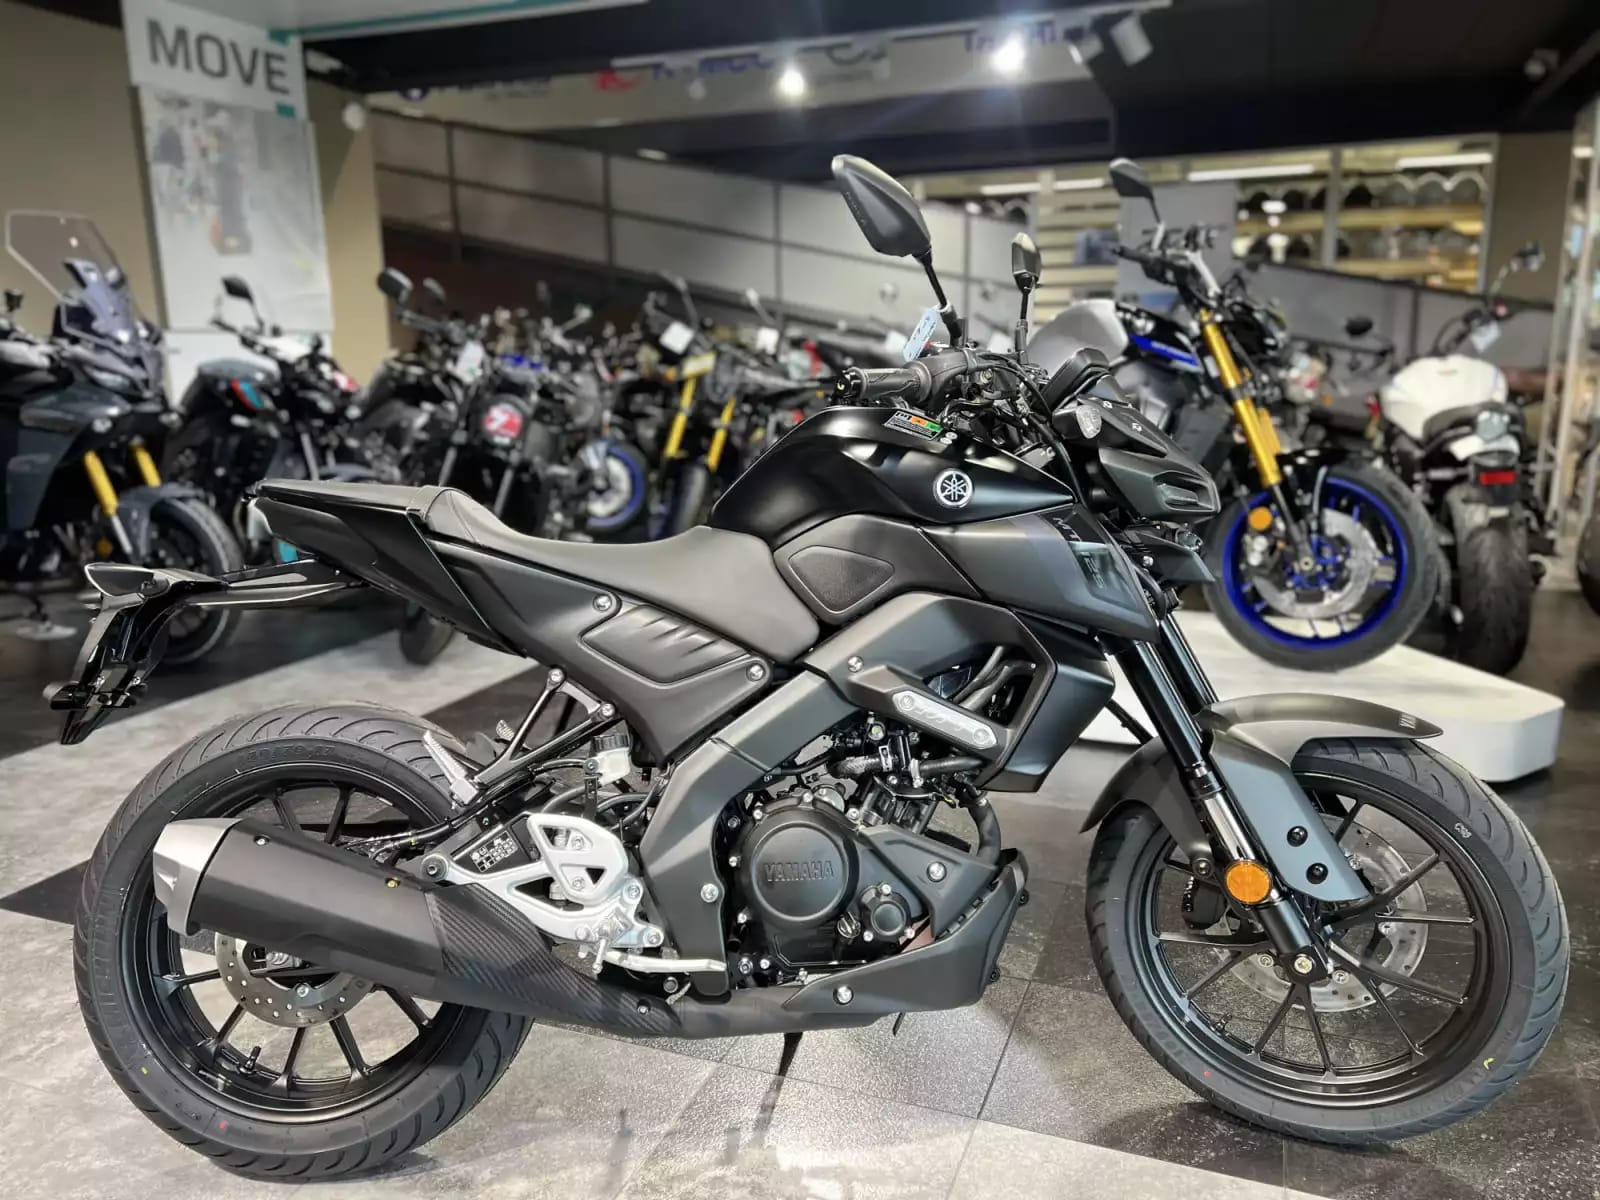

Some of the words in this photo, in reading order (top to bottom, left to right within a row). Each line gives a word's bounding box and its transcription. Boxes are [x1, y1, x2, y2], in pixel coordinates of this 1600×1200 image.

[148, 18, 290, 96] MOVE
[1052, 516, 1083, 541] MT
[764, 860, 834, 882] YAMAHA
